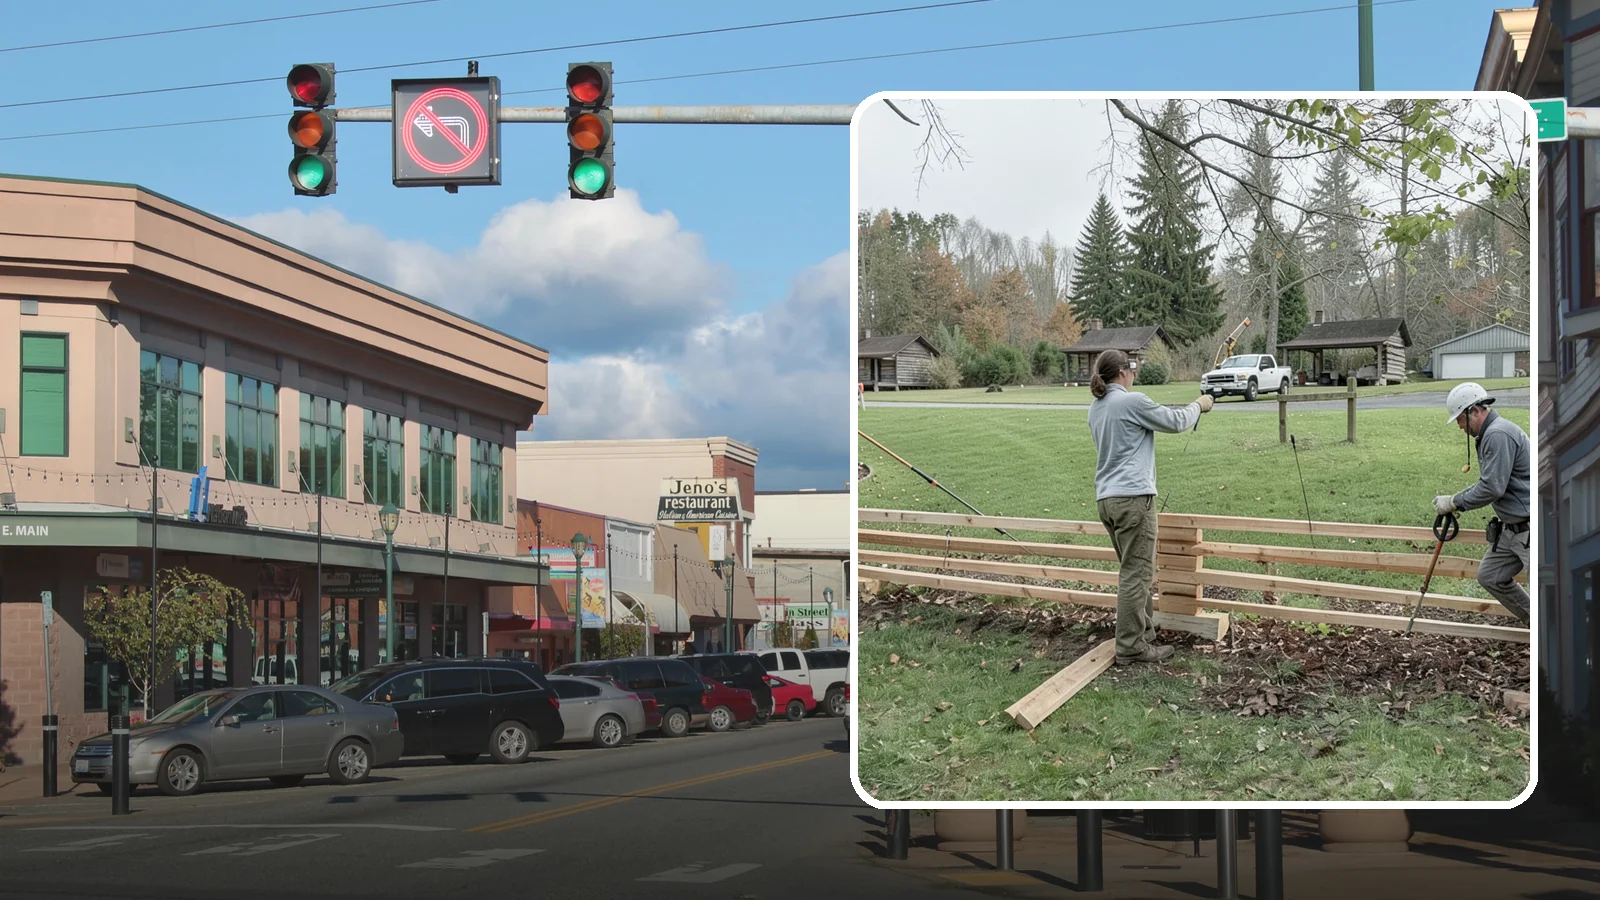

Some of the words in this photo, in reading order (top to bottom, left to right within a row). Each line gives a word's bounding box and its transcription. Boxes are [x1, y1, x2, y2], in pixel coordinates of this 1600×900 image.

[670, 480, 727, 494] Jeno's
[665, 496, 730, 509] restaurant
[658, 510, 682, 519] Italian
[686, 510, 714, 519] American
[715, 510, 737, 519] Cuisine
[2, 526, 12, 536] E.
[16, 526, 48, 536] MAIN
[798, 608, 828, 616] Street
